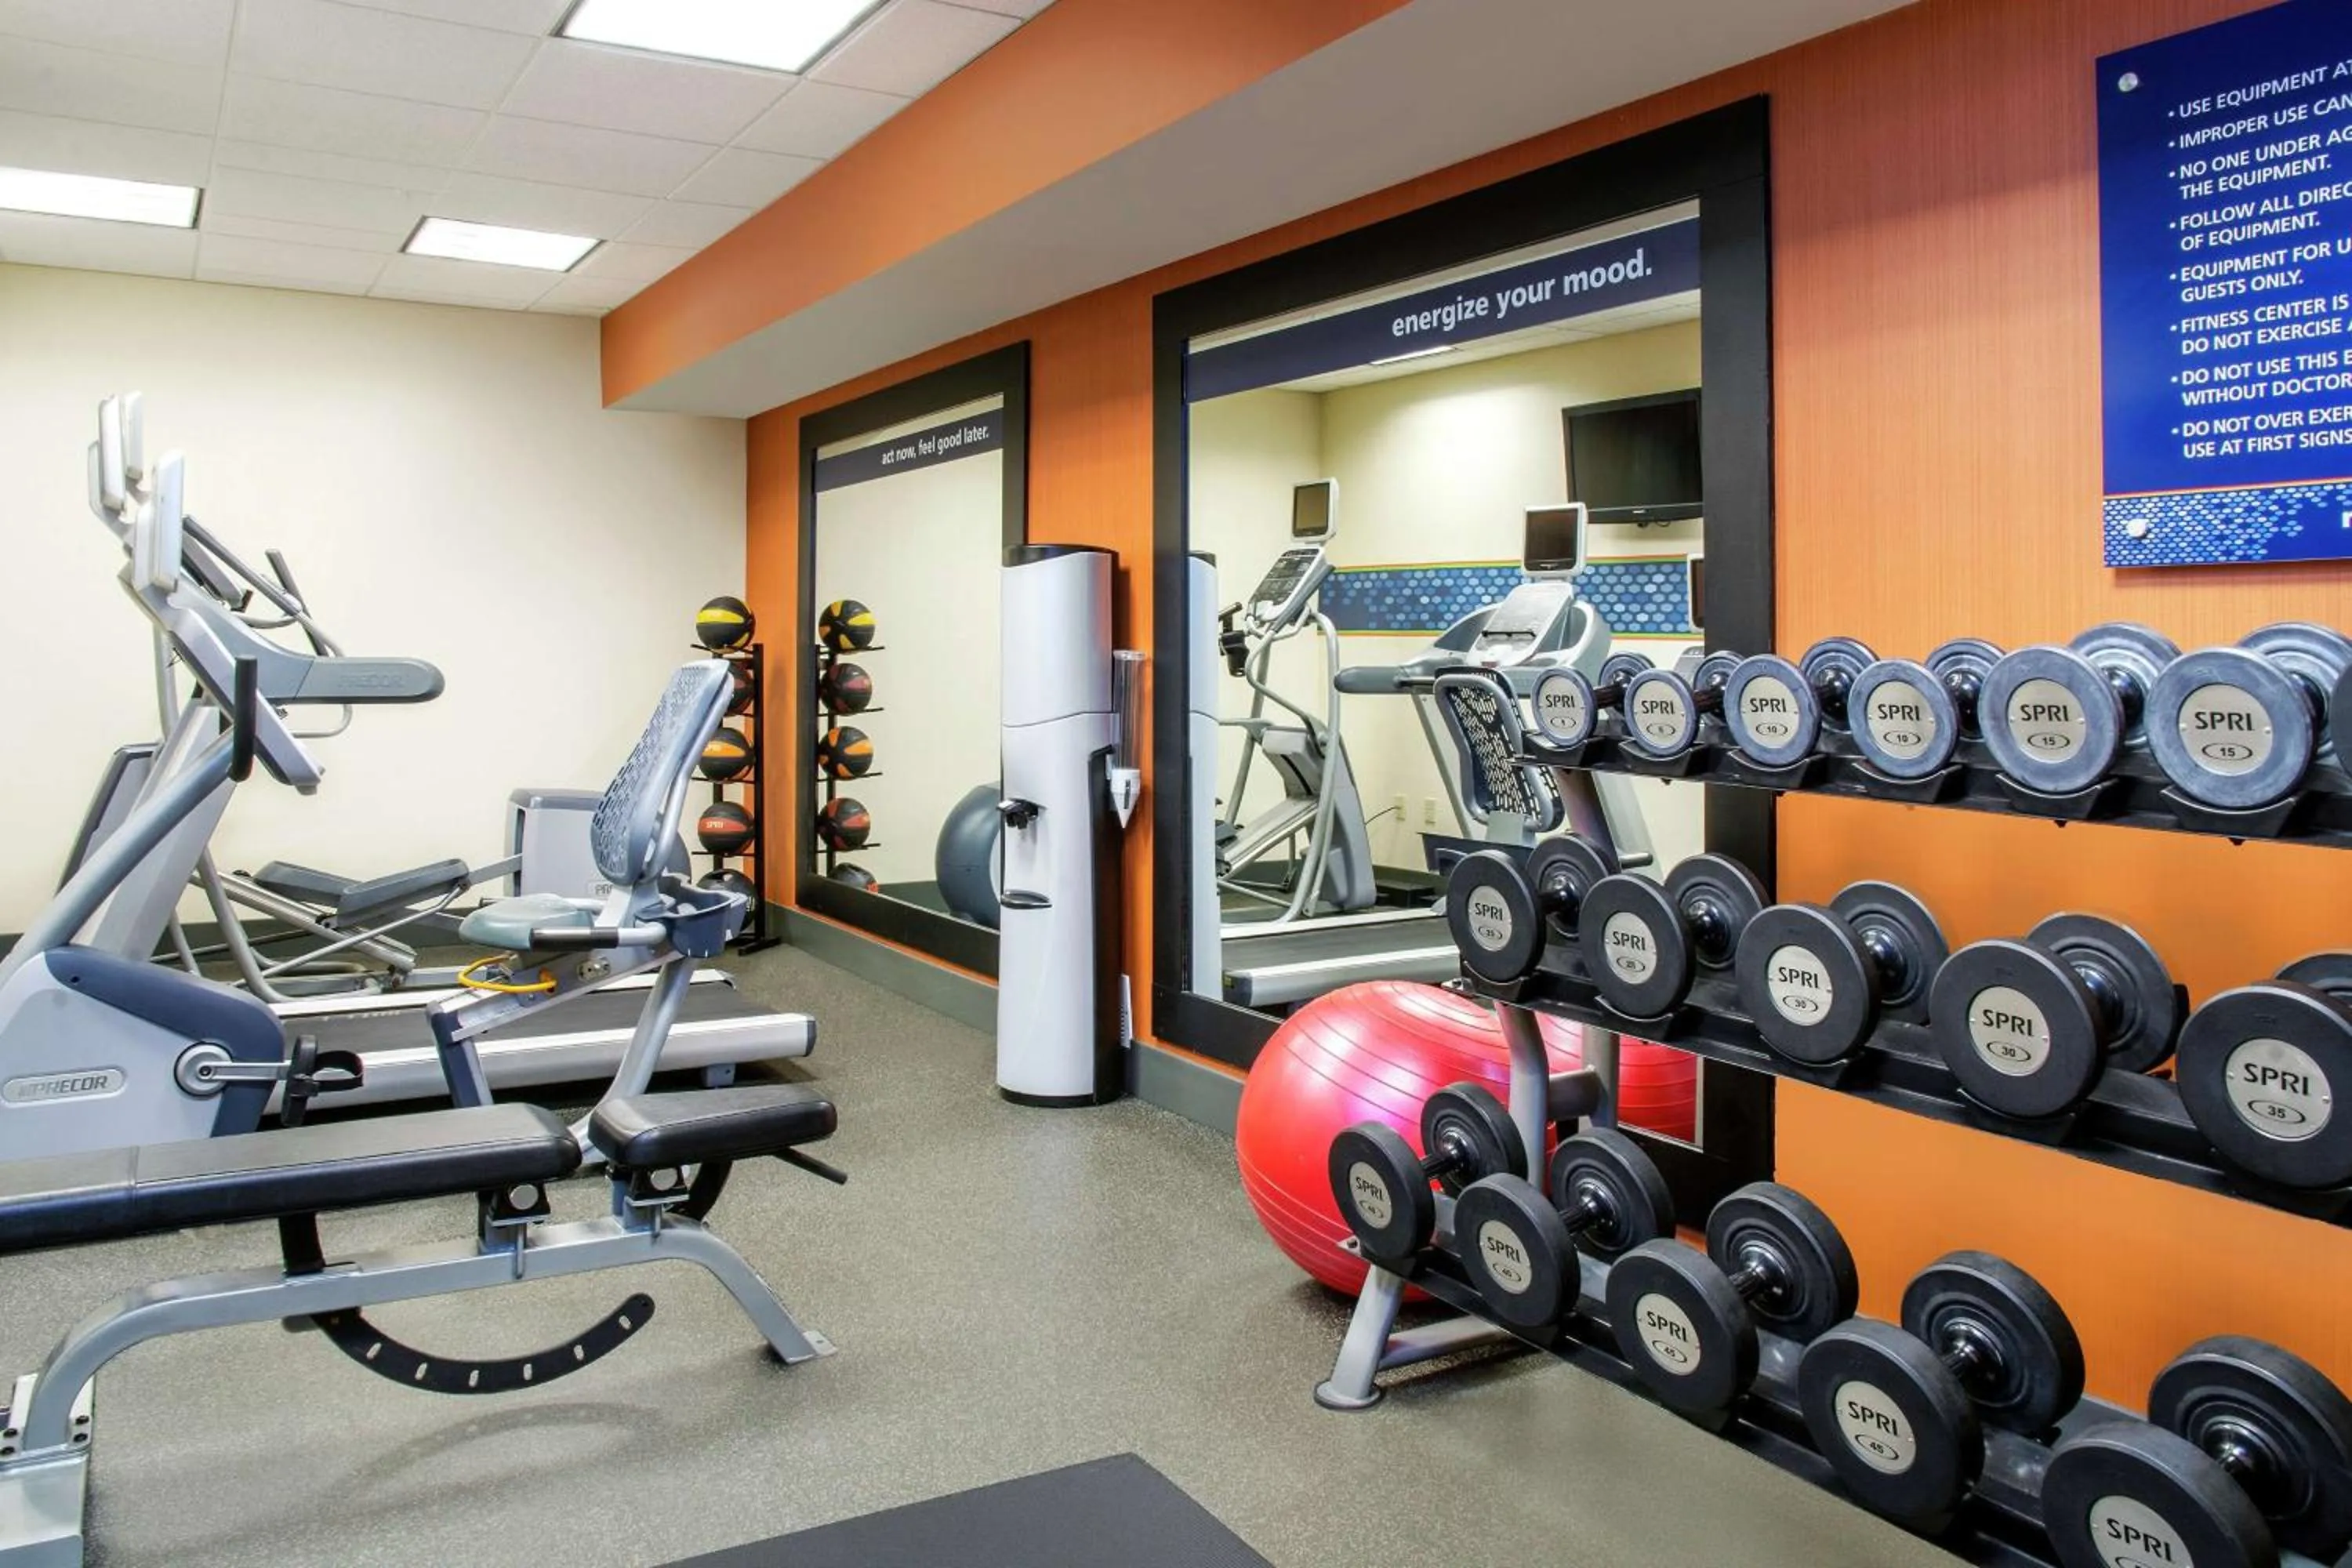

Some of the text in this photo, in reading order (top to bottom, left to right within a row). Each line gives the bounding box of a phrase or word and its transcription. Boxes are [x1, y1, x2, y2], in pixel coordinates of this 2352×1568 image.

[2180, 97, 2211, 118] USE
[2217, 67, 2327, 108] EQUIPMENT
[2180, 94, 2352, 148] IMPROPER USE CAN
[2180, 161, 2207, 179] NO
[2212, 151, 2249, 171] ONE
[2256, 134, 2321, 162] UNDER
[2180, 154, 2332, 199] THE EQUIPMENT.
[2180, 202, 2256, 230] FOLLOW
[2259, 195, 2294, 215] ALL
[2181, 212, 2320, 251] OF EQUIPMENT.
[2181, 249, 2288, 281] EQUIPMENT
[2292, 242, 2331, 262] FOR
[1392, 248, 1652, 336] energize your mood.
[2181, 269, 2303, 302] GUESTS ONLY.
[2181, 294, 2349, 333] FITNESS CENTER IS
[2182, 338, 2209, 354] DO
[2214, 331, 2252, 350] NOT
[2257, 318, 2342, 344] EXERCISE
[2182, 368, 2209, 385] DO
[2214, 362, 2252, 381] NOT
[2257, 358, 2291, 376] USE
[2296, 351, 2338, 371] THIS
[2182, 383, 2267, 406] WITHOUT
[2183, 421, 2209, 437] DO
[2214, 416, 2252, 434] NOT
[2255, 411, 2304, 430] OVER
[882, 449, 895, 464] act
[919, 436, 935, 455] feel
[938, 429, 961, 455] good
[964, 426, 989, 443] later.
[2183, 428, 2352, 458] USE AT FIRST SIGNS
[1545, 695, 1574, 707] SPRI
[1642, 700, 1675, 714] SPRI
[1749, 698, 1786, 713] SPRI
[1878, 704, 1919, 720] SPRI
[2020, 704, 2069, 721] SPRI
[2194, 711, 2252, 731] SPRI
[1896, 734, 1908, 742] 10
[2042, 736, 2056, 746] 15
[2220, 747, 2235, 757] 15
[1475, 902, 1503, 920] SPRI
[1613, 931, 1646, 950] SPRI
[1778, 967, 1819, 989] SPRI
[1983, 1009, 2033, 1036] SPRI
[2002, 1047, 2016, 1058] 30
[33, 1075, 108, 1097] PRECOR
[2244, 1062, 2309, 1096] SPRI
[2267, 1105, 2286, 1119] 35
[1356, 1177, 1384, 1201] SPRI
[1487, 1236, 1520, 1262] SPRI
[1647, 1311, 1687, 1342] SPRI
[1848, 1401, 1898, 1437] SPRI
[2107, 1518, 2172, 1563] SPRI
